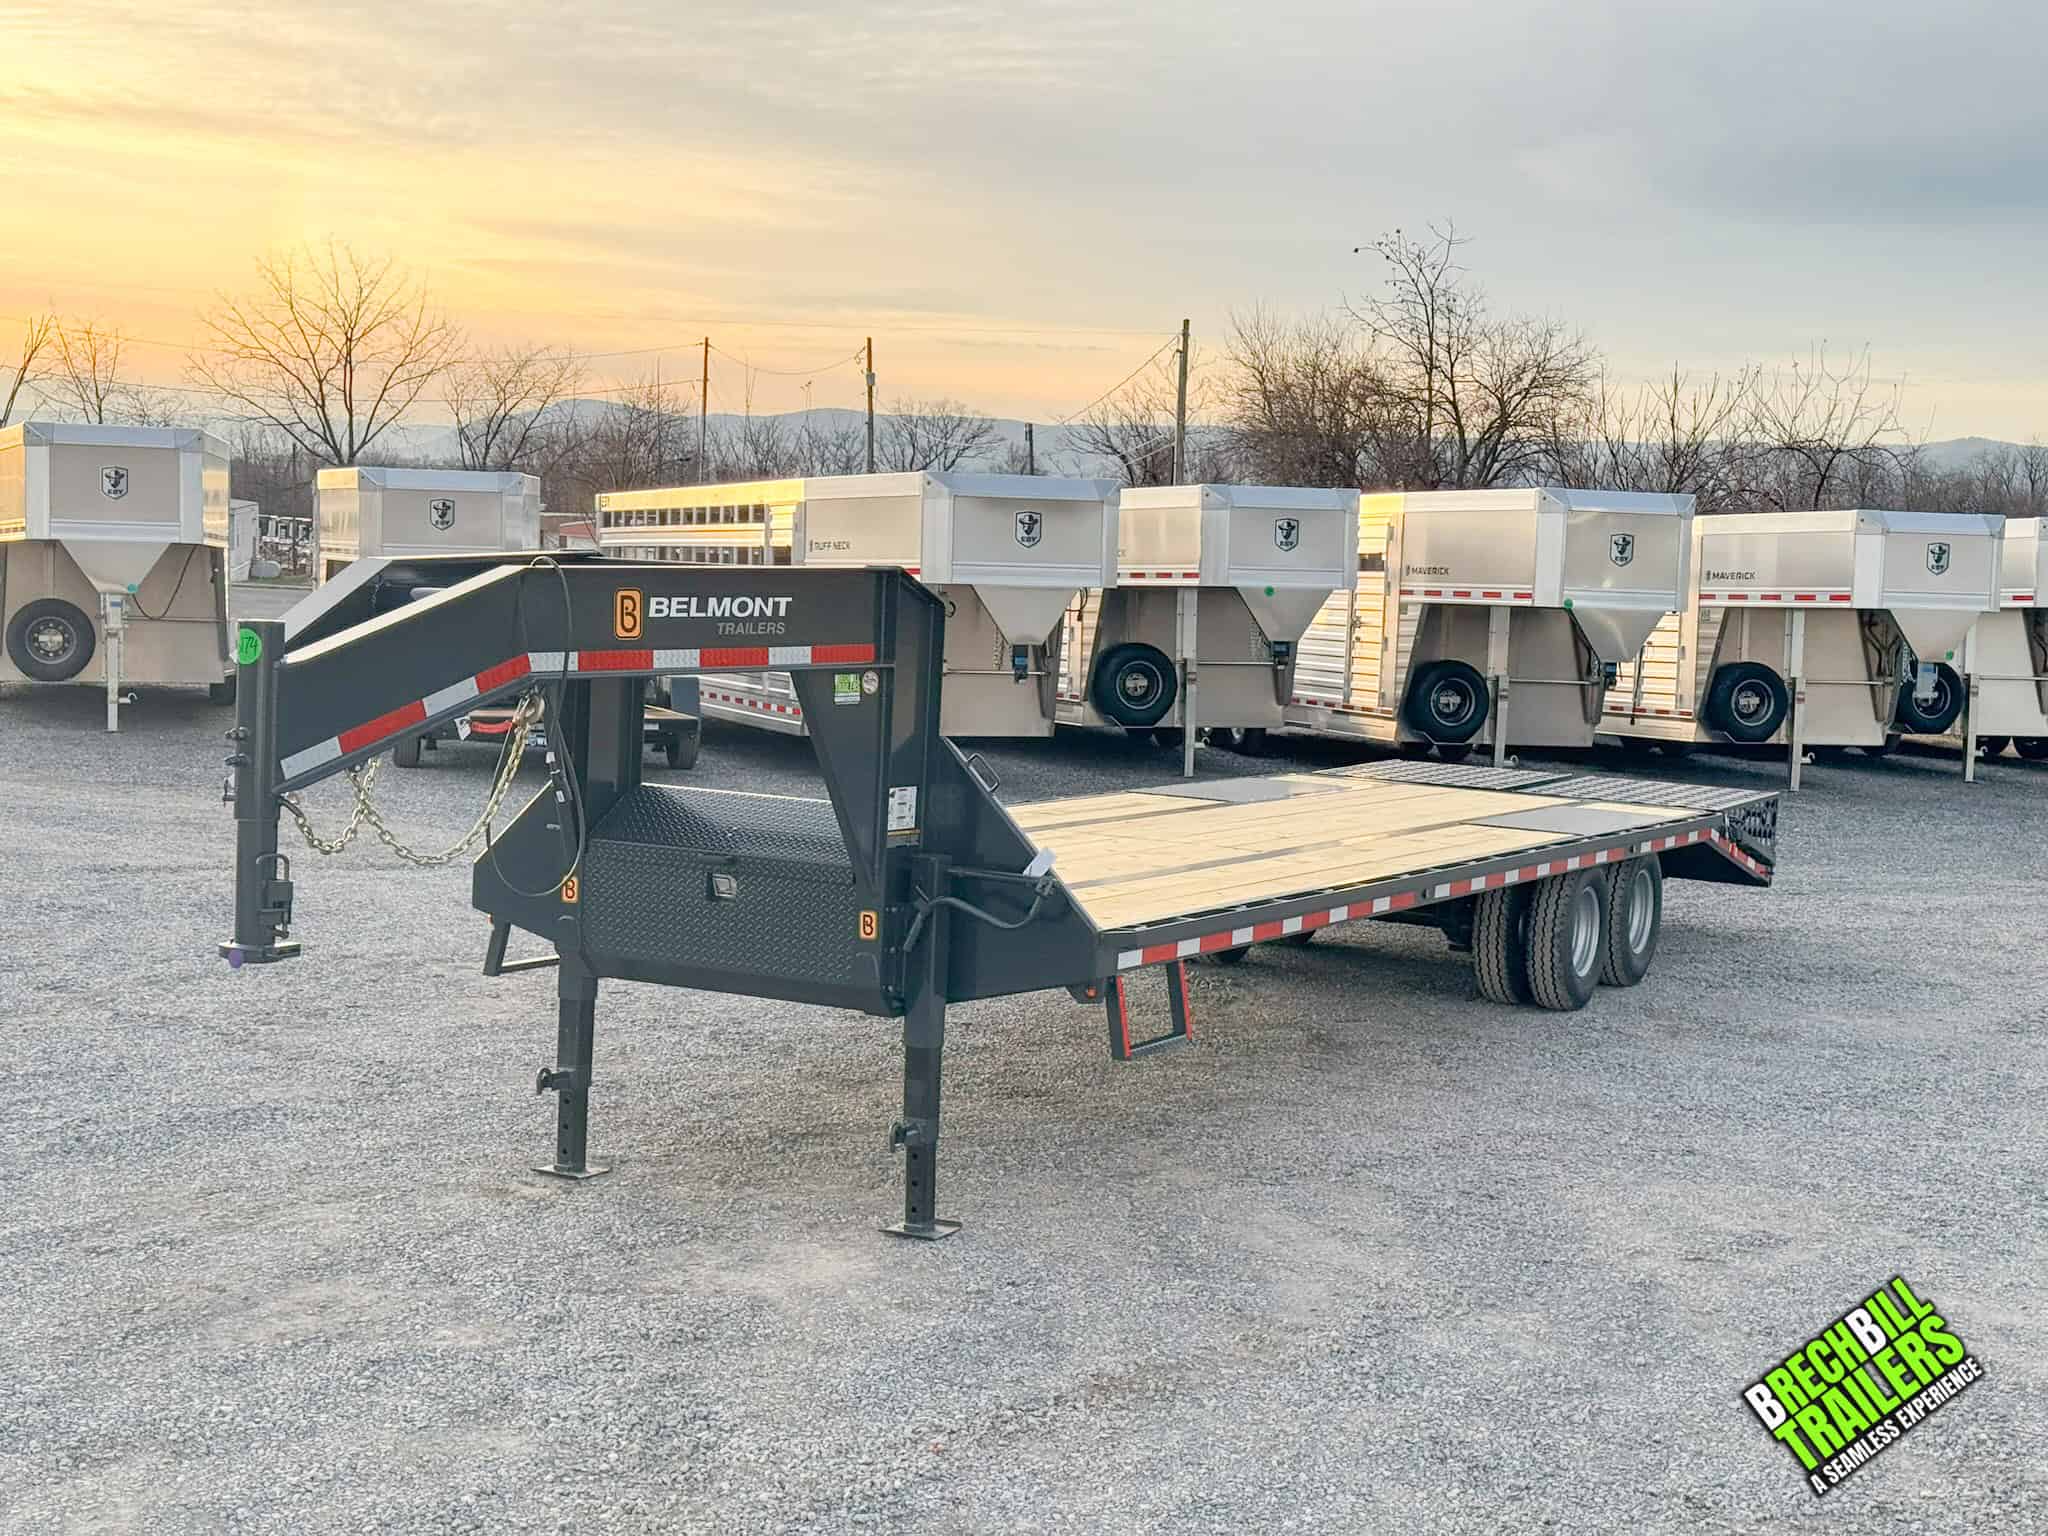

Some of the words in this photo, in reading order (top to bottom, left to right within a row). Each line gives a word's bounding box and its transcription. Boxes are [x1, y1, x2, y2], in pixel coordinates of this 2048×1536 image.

[1411, 567, 1450, 576] MAVERICK
[1711, 571, 1756, 580] MAVERICK
[648, 596, 793, 618] BELMONT
[717, 622, 786, 635] TRAILERS
